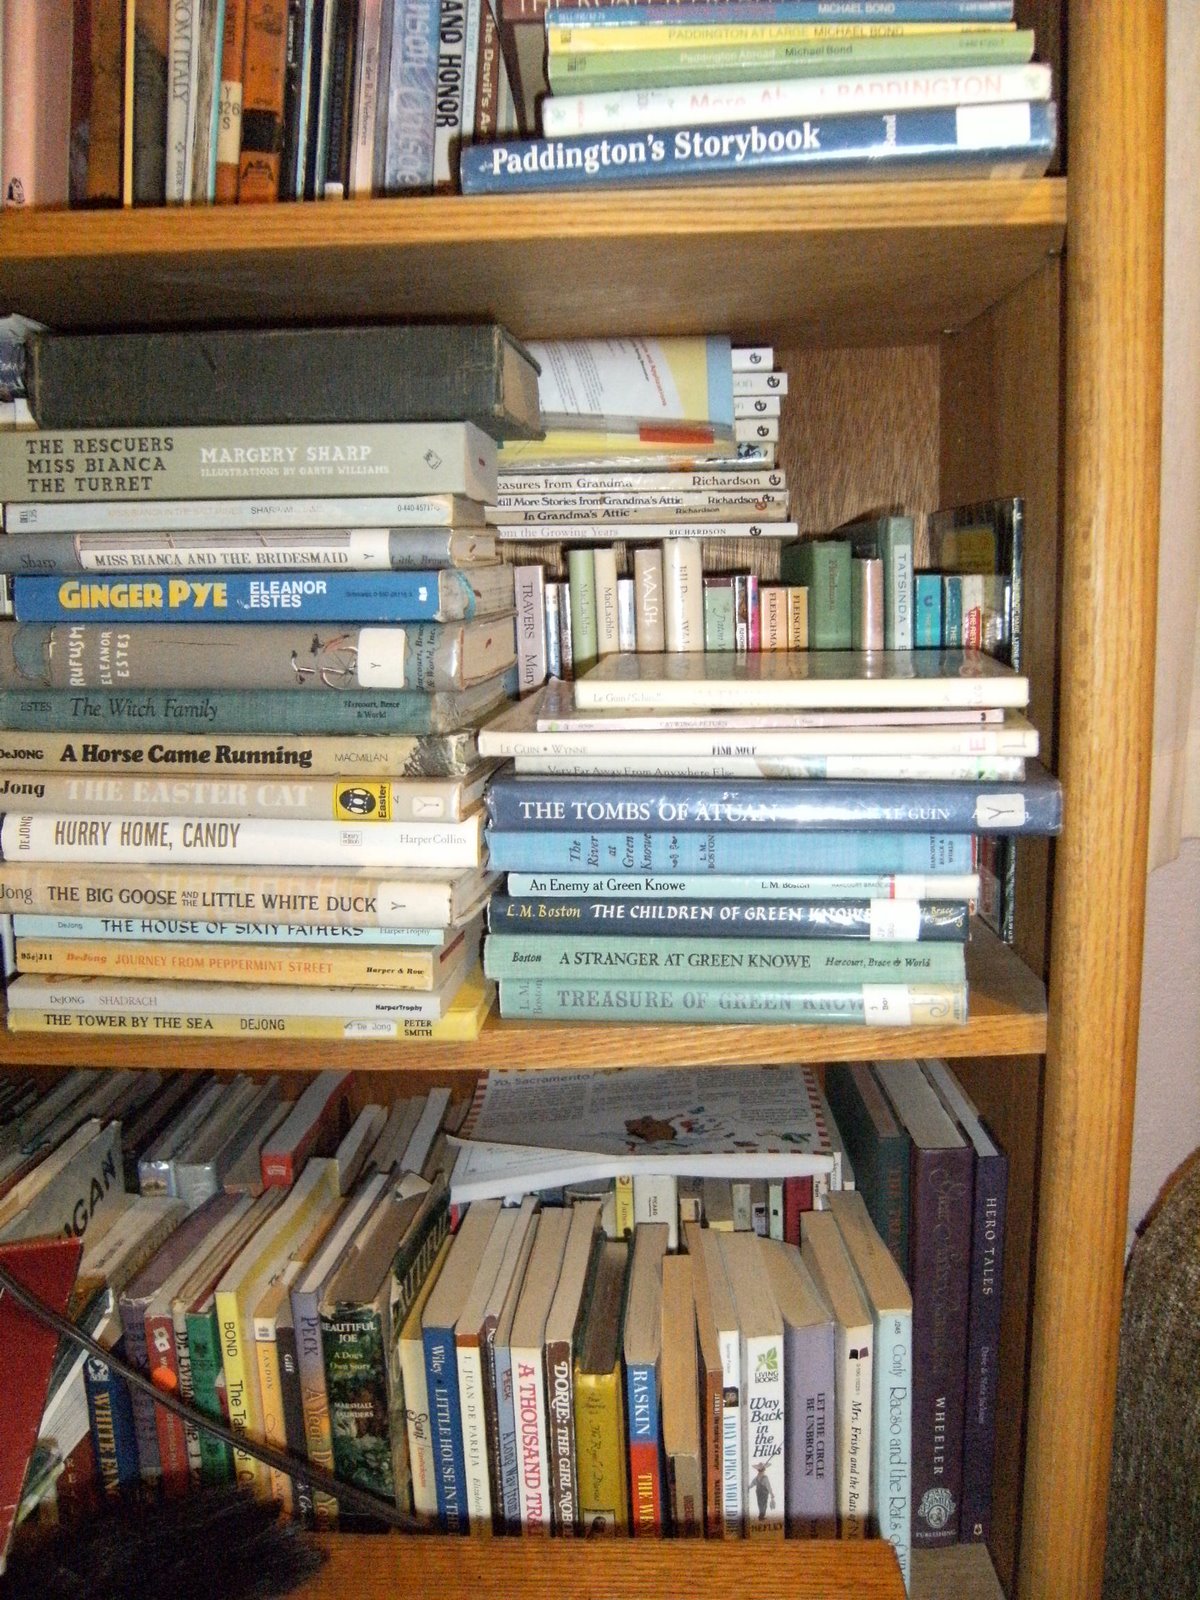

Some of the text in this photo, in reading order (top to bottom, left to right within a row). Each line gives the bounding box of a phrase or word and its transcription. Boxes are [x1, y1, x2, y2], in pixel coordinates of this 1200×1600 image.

[818, 2, 895, 14] MICHAEL BOND
[668, 27, 747, 40] PADDINGTON
[814, 25, 866, 38] MICHAEL
[869, 24, 904, 37] BOND
[784, 44, 853, 57] Michael Bond
[437, 0, 463, 128] AND HONOR
[481, 49, 494, 108] Devil's
[492, 121, 821, 175] Paddington's Storybook
[26, 437, 174, 454] THE RESCUERS
[201, 446, 372, 464] MARGERY SHARP
[28, 457, 167, 474] MISS BIANCA
[201, 467, 281, 478] ILLUSTRATIONS
[28, 476, 153, 493] THE TURRET
[692, 475, 760, 487] Richardson
[541, 495, 657, 506] Stories Grandma's
[708, 495, 759, 505] Richardson
[537, 508, 630, 520] Grandma's Attic
[540, 527, 587, 540] Growing
[669, 528, 727, 536] RICHARDSON
[20, 554, 56, 570] Sharp
[95, 551, 348, 566] MISS BIANCA AND THE BRIDESMAID
[58, 580, 228, 610] GINGER PYE
[250, 580, 327, 595] ELEANOR
[642, 566, 658, 626] WALSH
[898, 553, 907, 624] TATSINDA
[250, 594, 302, 608] ESTES
[523, 582, 535, 640] TRAVERS
[605, 586, 613, 640] MacLachlan
[69, 640, 86, 687] RUFUS
[101, 631, 113, 686] ELEANOR
[116, 633, 130, 678] ESTES
[70, 697, 218, 721] The Witch Family
[60, 745, 313, 768] A Horse Came Running
[335, 753, 388, 762] MACMILLAN
[0, 780, 45, 798] Jong
[67, 780, 314, 806] THE EASTER CAT
[378, 785, 387, 819] Easter
[519, 802, 776, 823] THE TOMBS OF ATUAN
[55, 821, 240, 850] HURRY HOME, CANDY
[400, 834, 467, 846] HarperCollins
[569, 839, 581, 861] The
[587, 835, 599, 867] River
[622, 836, 634, 868] Green
[0, 884, 33, 904] Jong
[47, 886, 177, 905] THE BIG GOOSE
[181, 891, 199, 899] AND
[530, 879, 686, 894] An Enemy Green Knowe
[202, 892, 377, 913] LITTLE WHITE DUCK
[538, 904, 580, 918] Boston
[590, 904, 802, 921] THE CHILDREN OF GREEN
[101, 919, 364, 937] THE HOUSE OF SIXTY FATHERS
[66, 953, 107, 964] DeJong
[115, 954, 333, 973] JOURNEY FROM PEPPERMINT STREET
[512, 952, 542, 963] Boston
[559, 953, 811, 968] A STRANGER AT GREEN KNOWE
[100, 996, 157, 1006] SHADRACH
[375, 1003, 422, 1012] HarperTrophy
[557, 990, 793, 1010] TREASURE OF GREEN
[44, 1014, 214, 1029] THE TOWER BY THE SEA
[240, 1019, 285, 1030] DEJONG
[404, 1029, 432, 1037] SMITH
[982, 1198, 997, 1296] HERO TALES
[300, 1316, 319, 1356] PECK
[339, 1334, 358, 1344] JOE
[224, 1321, 243, 1406] BOND The
[750, 1397, 780, 1411] Way
[431, 1345, 455, 1482] Wiley LITTLE HOUSE
[750, 1410, 784, 1423] Back
[518, 1363, 541, 1489] A THOUSAND
[552, 1361, 571, 1490] DORIE: THE GIRL
[633, 1370, 653, 1500] RASKIN THE
[755, 1433, 774, 1445] the
[848, 1427, 861, 1456] Frisby
[888, 1344, 908, 1531] Conly Racso and the Rats
[933, 1397, 946, 1475] WHEELER
[753, 1445, 782, 1458] Hills
[805, 1415, 815, 1476] UNBROKEN
[816, 1440, 825, 1480] CIRCLE
